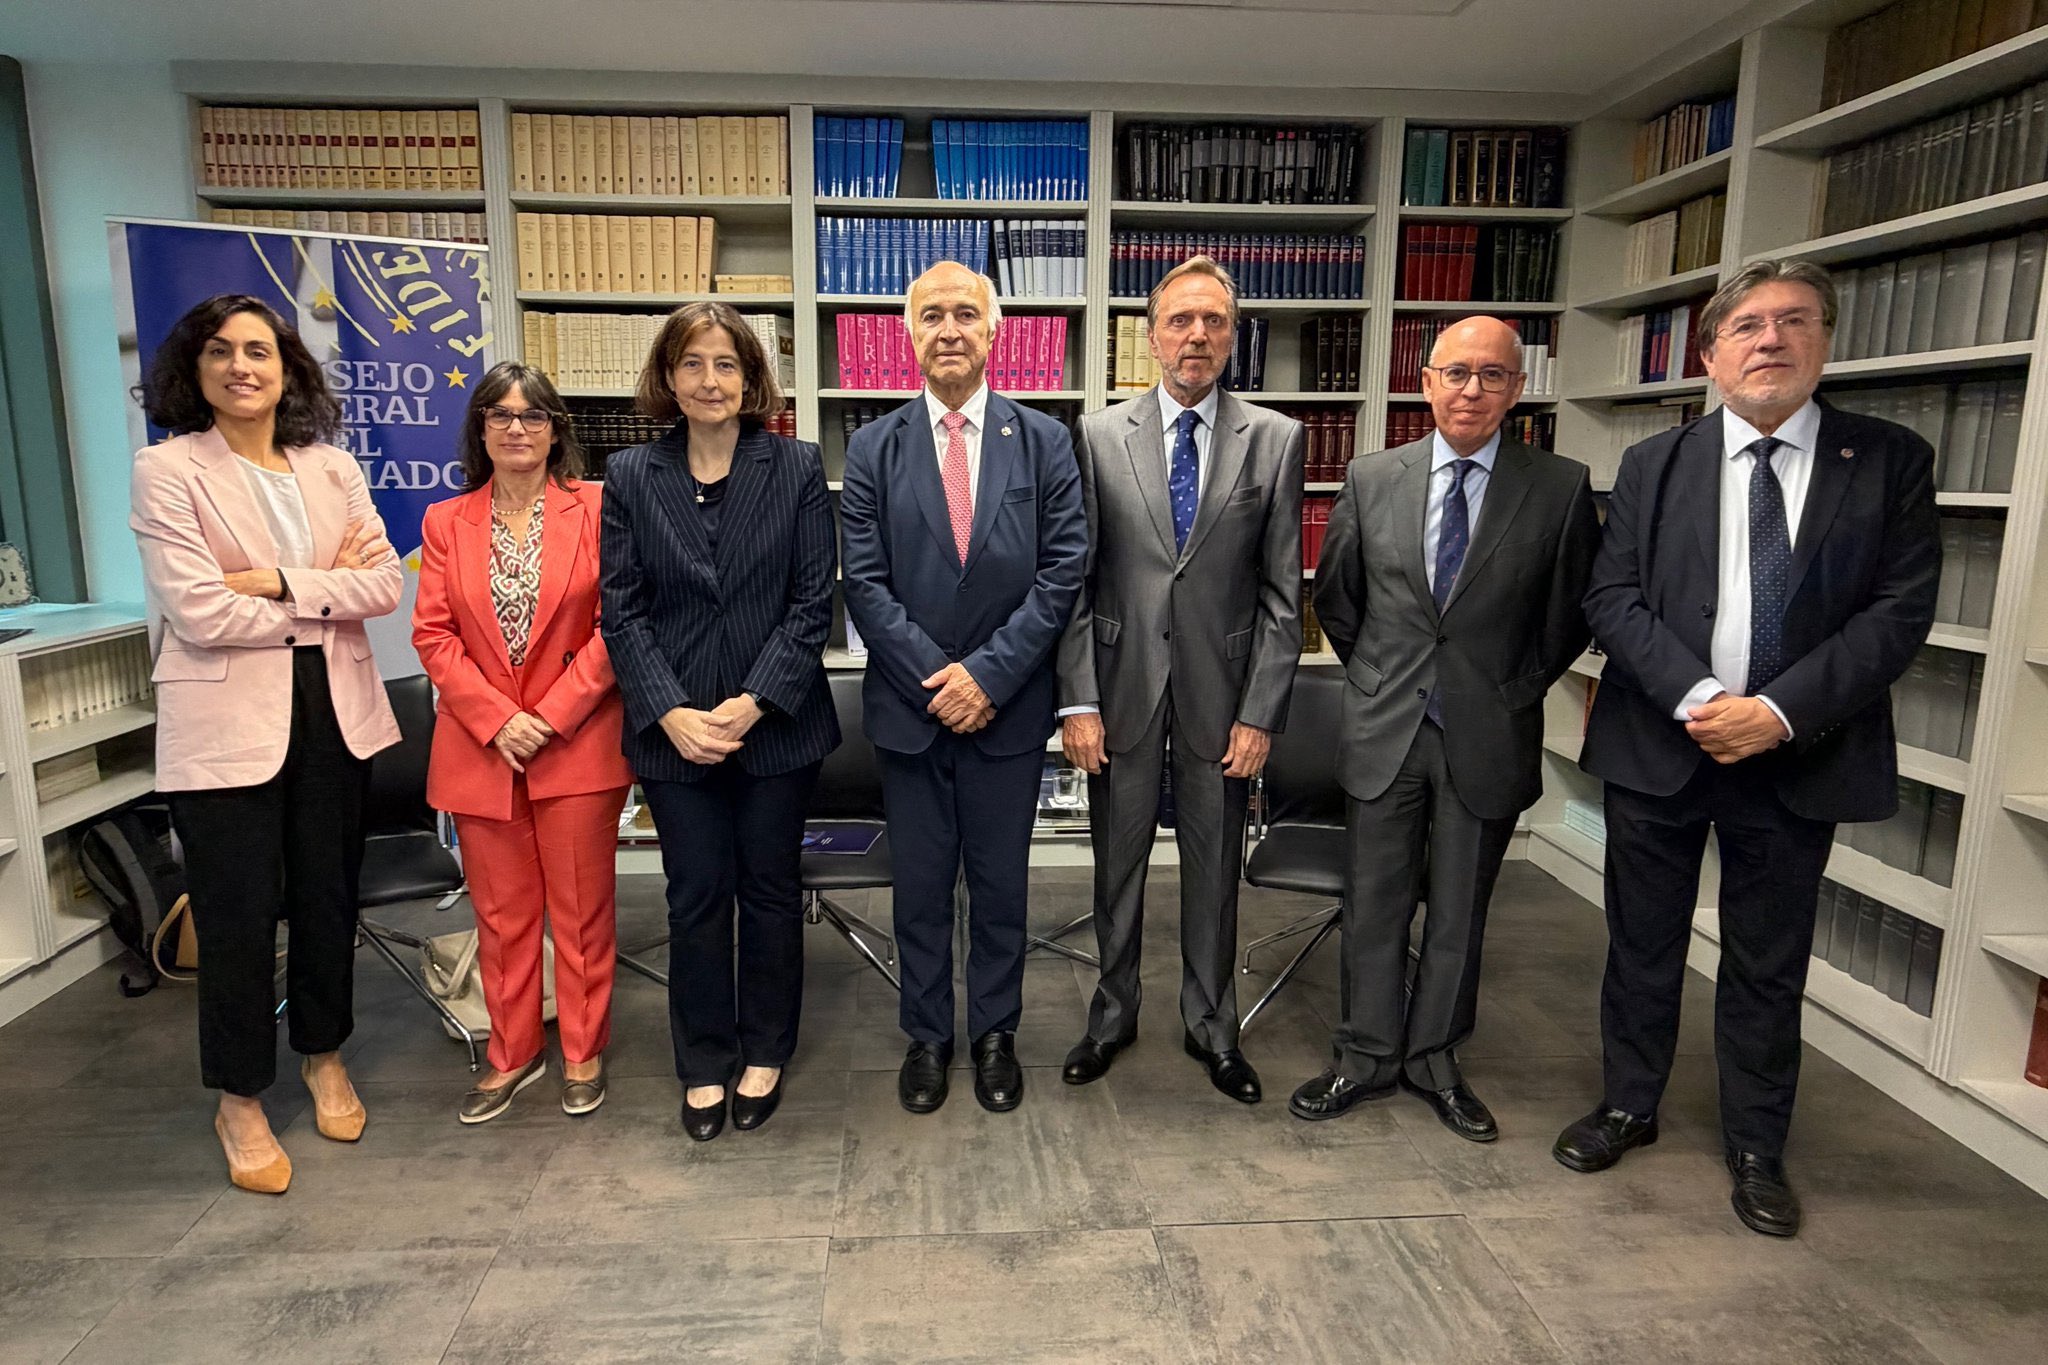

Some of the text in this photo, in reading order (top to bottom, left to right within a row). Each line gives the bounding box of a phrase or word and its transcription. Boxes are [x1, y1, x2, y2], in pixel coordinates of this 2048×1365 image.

[326, 360, 435, 393] SEJO
[333, 394, 440, 426] ERAL
[336, 428, 382, 457] EL
